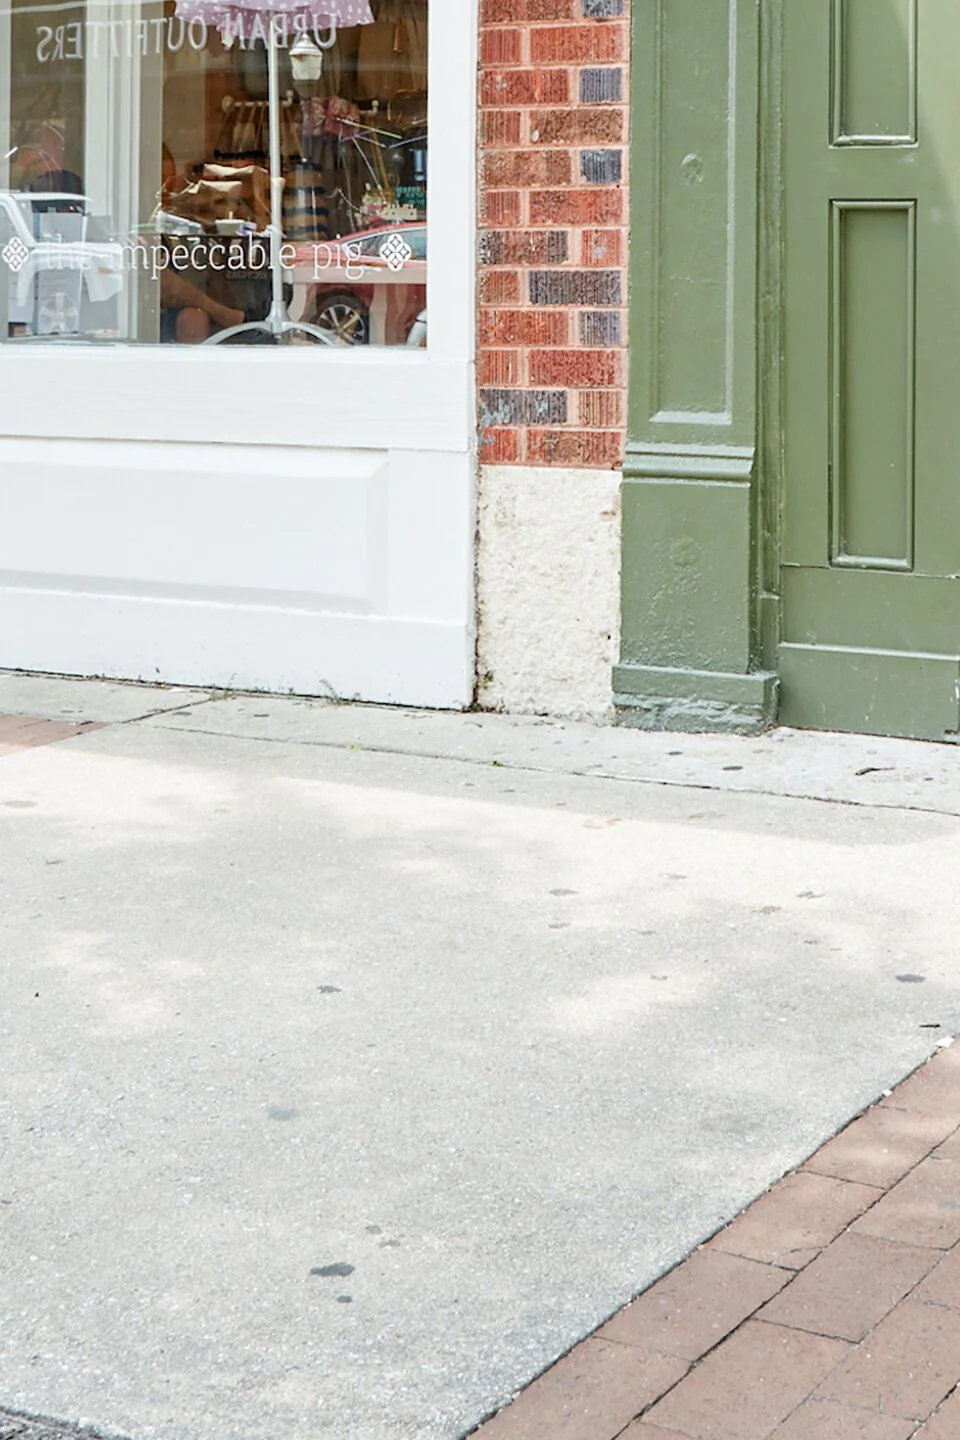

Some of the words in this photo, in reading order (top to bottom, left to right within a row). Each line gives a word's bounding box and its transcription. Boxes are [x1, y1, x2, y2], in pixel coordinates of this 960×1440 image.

[46, 233, 93, 271] the
[111, 233, 297, 280] impeccable
[312, 233, 364, 281] pig
